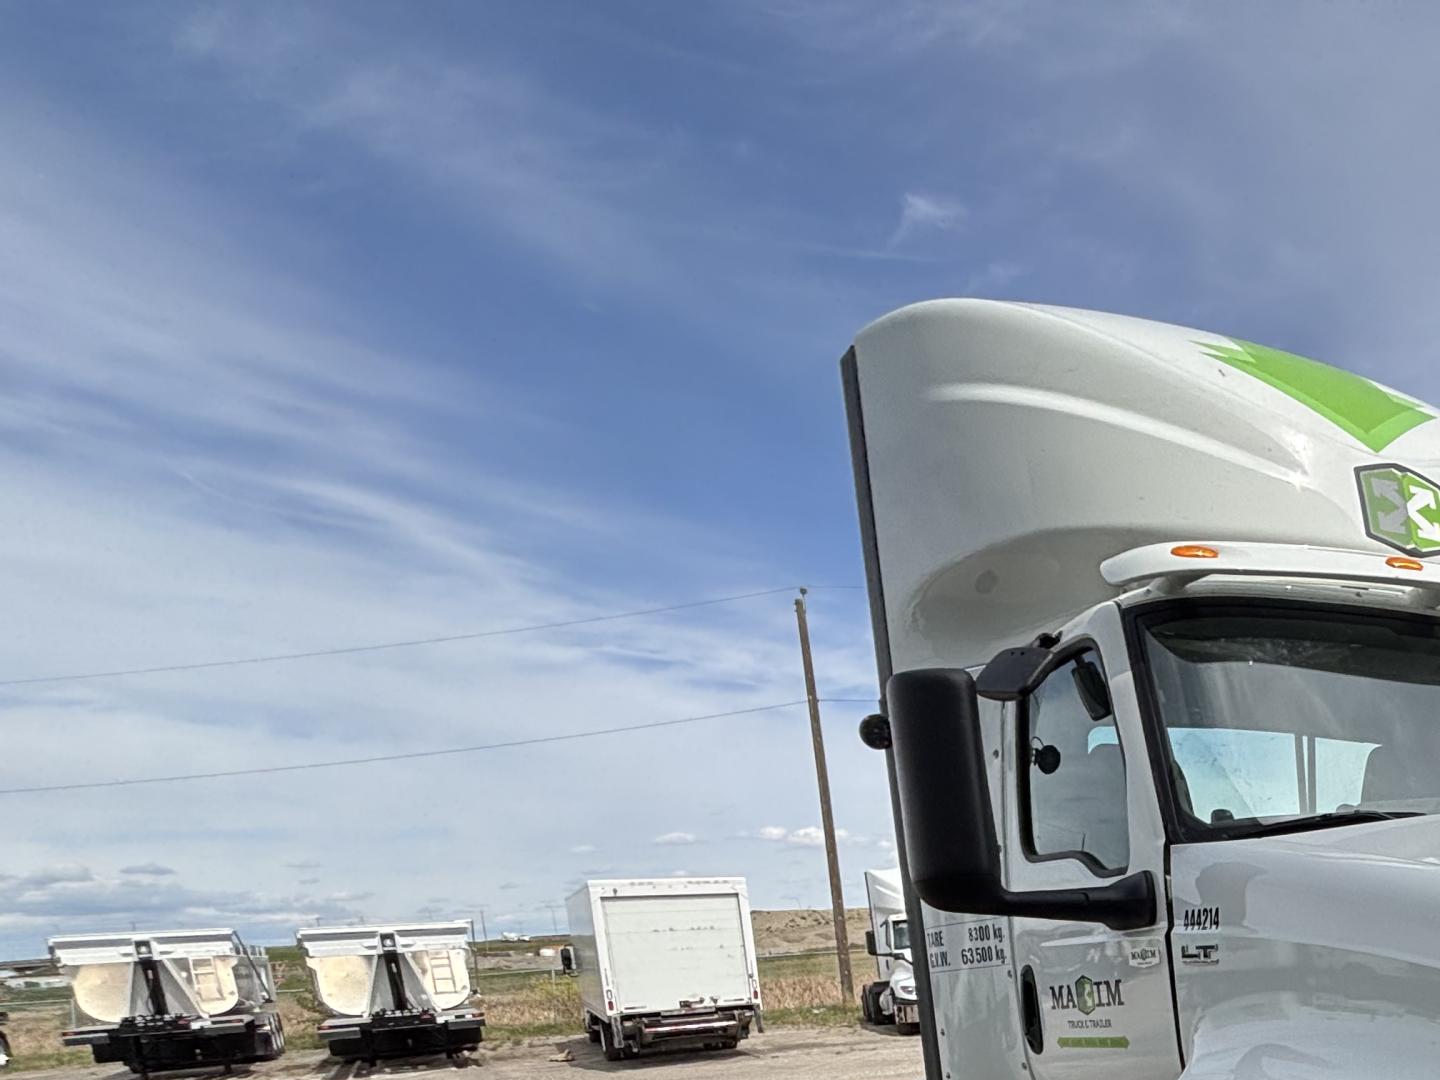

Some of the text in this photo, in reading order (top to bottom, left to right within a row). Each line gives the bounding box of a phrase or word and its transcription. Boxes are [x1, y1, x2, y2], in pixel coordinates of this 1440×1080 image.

[1184, 907, 1219, 931] 444214
[927, 931, 944, 948] TARE
[968, 925, 990, 942] 8300
